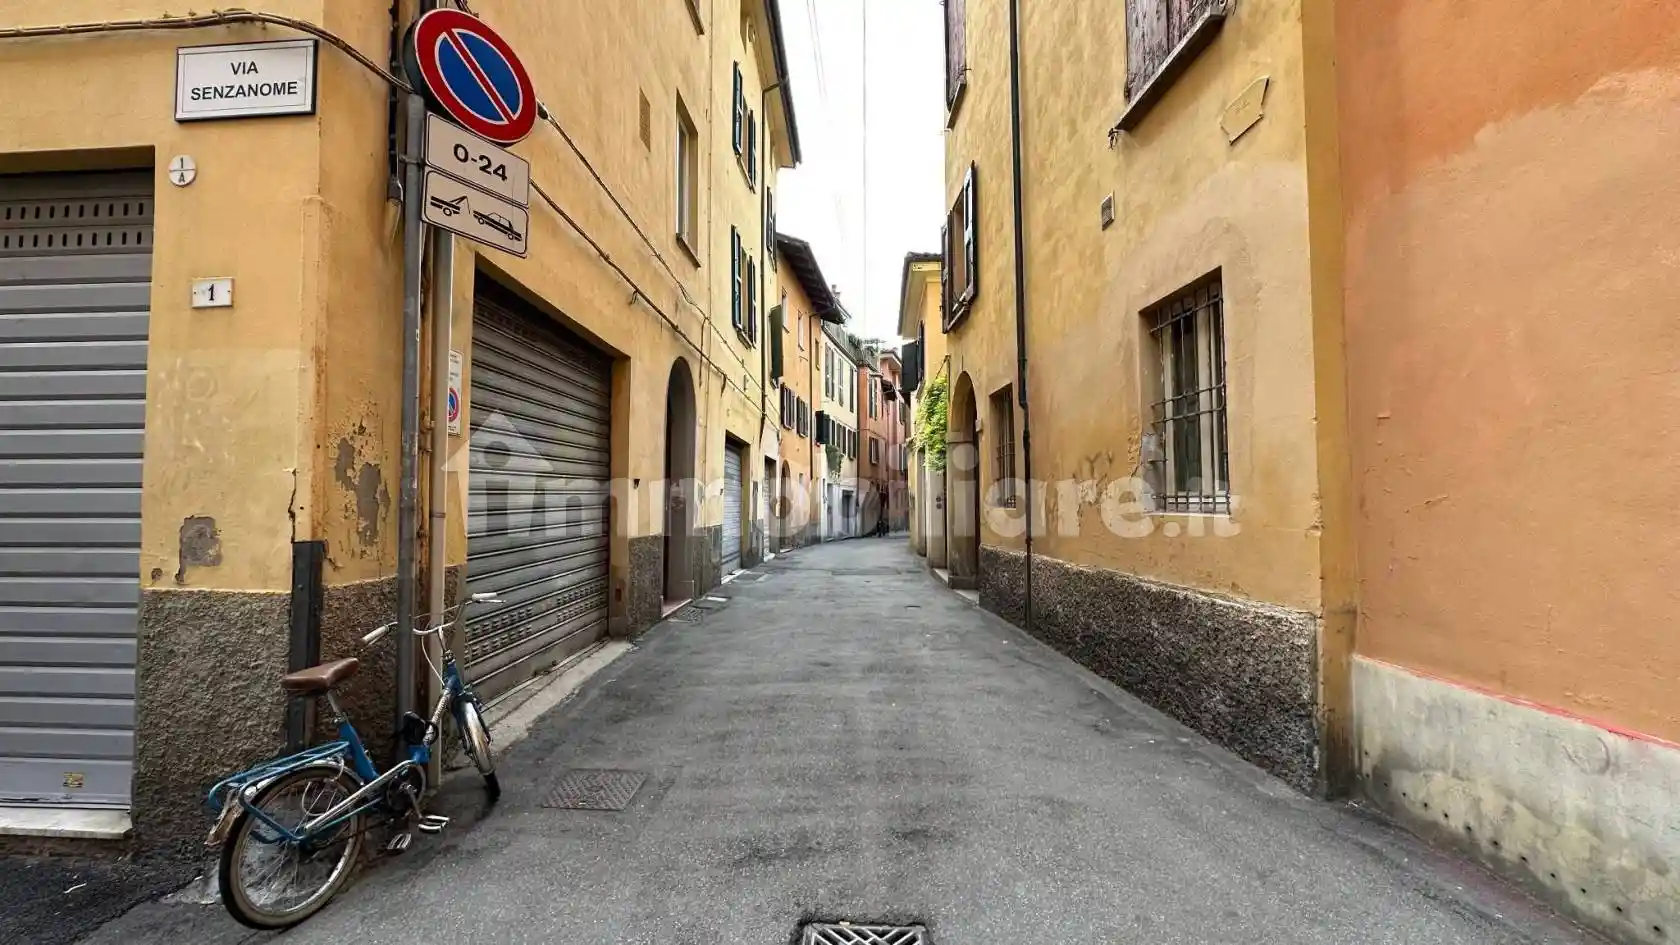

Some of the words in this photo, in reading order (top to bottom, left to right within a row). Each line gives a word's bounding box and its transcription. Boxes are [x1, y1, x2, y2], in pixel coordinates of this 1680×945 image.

[230, 60, 259, 76] VIA
[190, 81, 298, 101] SENZANOME
[179, 157, 185, 170] 1
[453, 143, 508, 182] 0-24
[178, 172, 186, 184] A
[207, 283, 216, 302] 1
